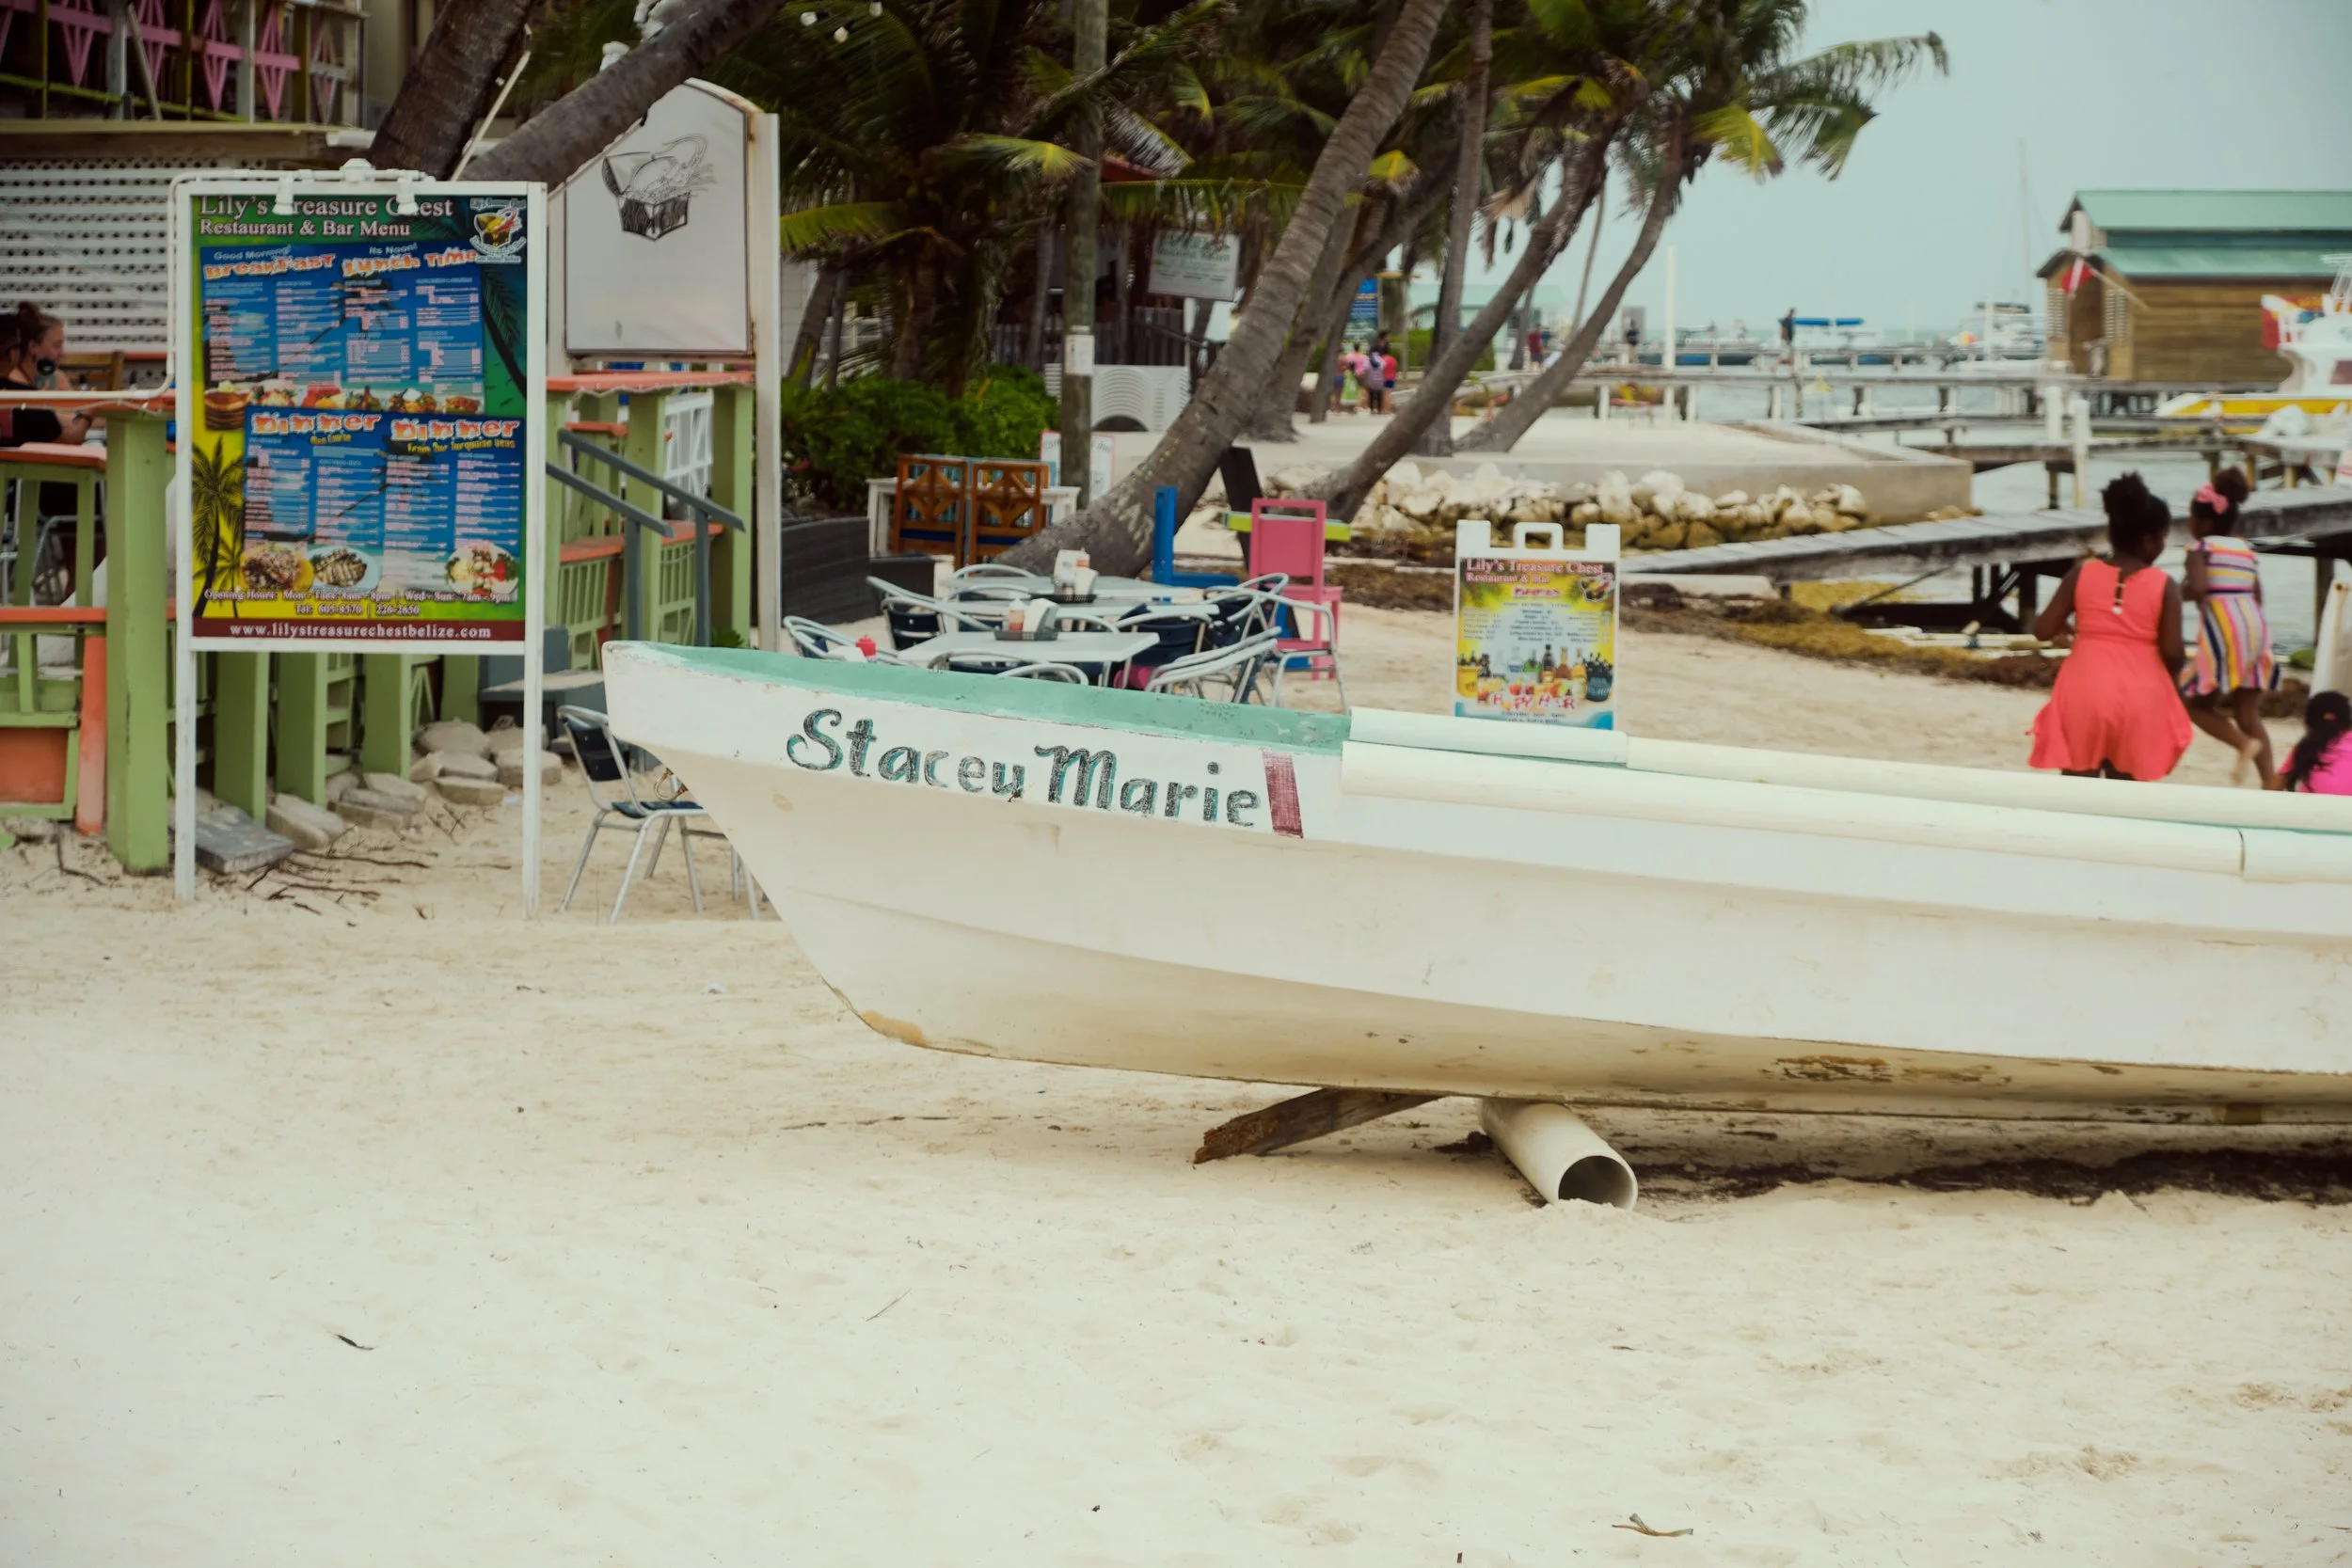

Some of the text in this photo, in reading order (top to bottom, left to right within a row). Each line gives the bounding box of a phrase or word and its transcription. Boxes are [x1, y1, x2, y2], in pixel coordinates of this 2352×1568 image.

[200, 195, 268, 219] Lily's
[290, 198, 376, 216] reasure
[385, 197, 453, 216] Cest
[199, 218, 410, 236] Restaurant & Bar Menu
[1465, 558, 1505, 575] Lily's
[203, 588, 245, 602] Opening
[230, 622, 492, 640] www.lilystreasurechestbelize.com
[1033, 744, 1260, 828] Marie
